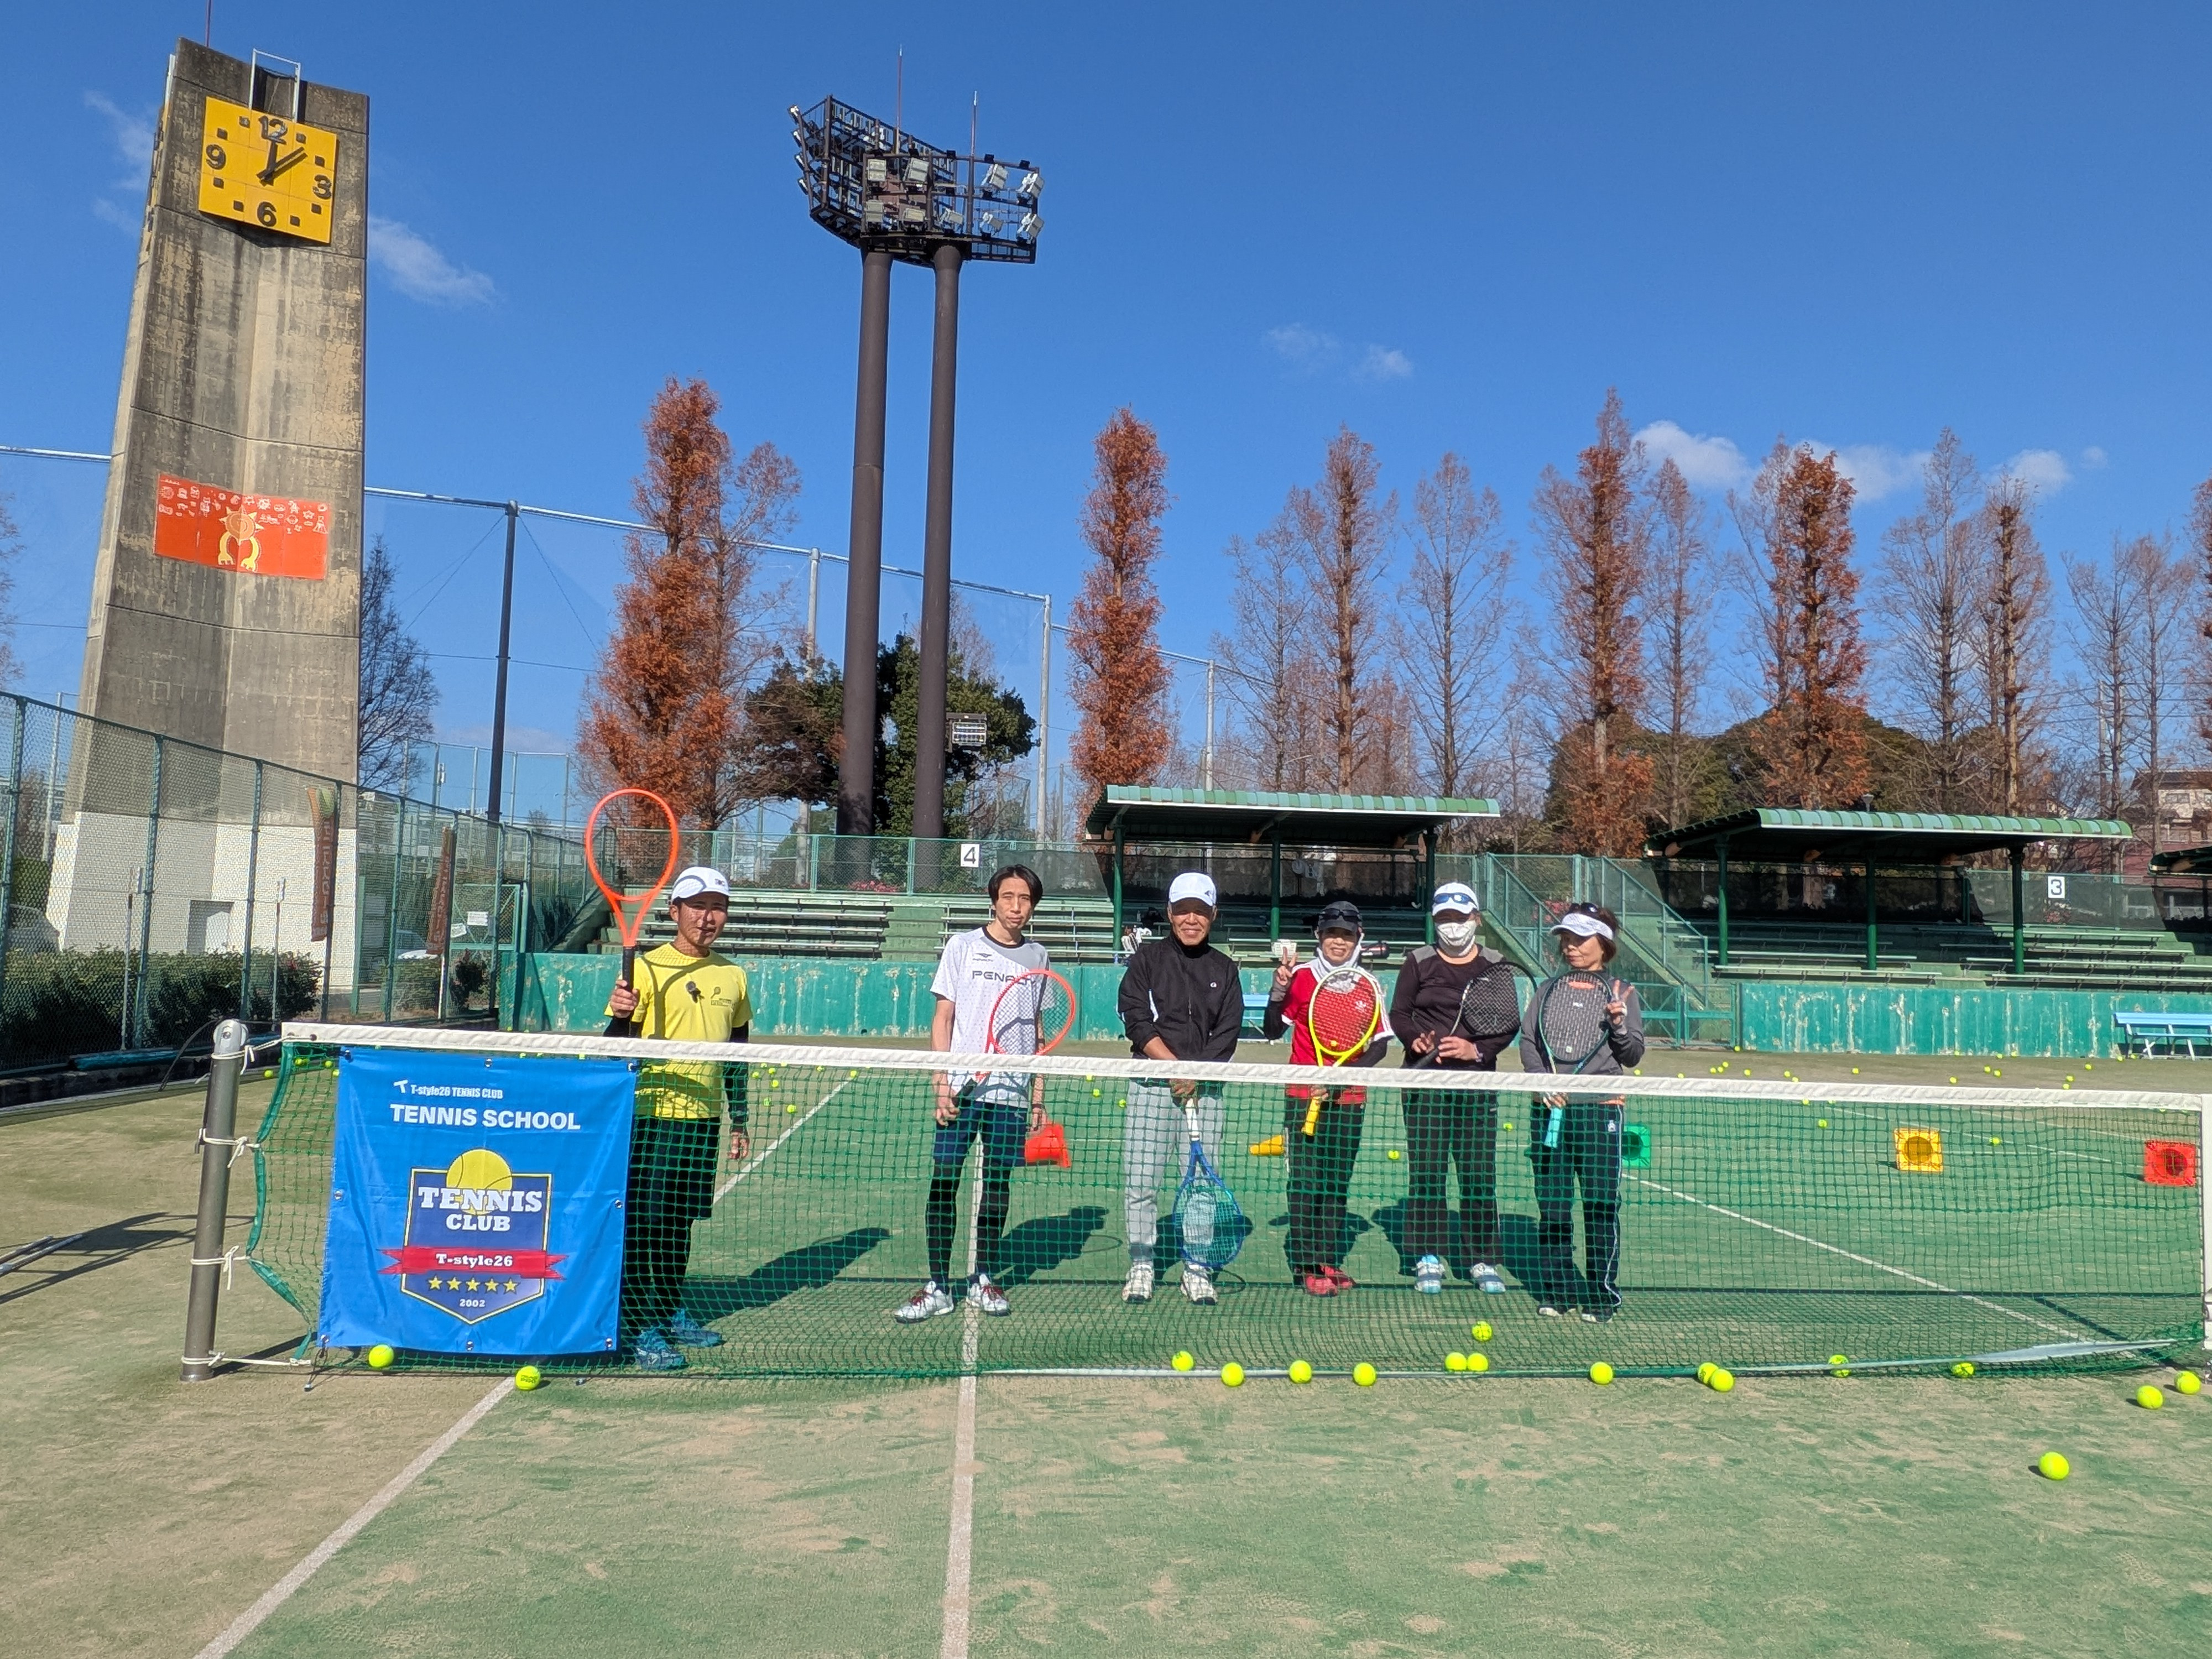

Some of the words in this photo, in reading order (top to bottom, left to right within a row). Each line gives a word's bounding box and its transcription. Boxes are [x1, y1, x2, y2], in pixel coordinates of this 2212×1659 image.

[259, 116, 288, 145] 12
[206, 144, 226, 170] 9
[312, 174, 332, 200] 3
[257, 202, 276, 227] 6
[963, 847, 976, 864] 4
[2051, 879, 2062, 895] 3
[452, 1087, 481, 1098] TENNIS
[482, 1088, 503, 1099] CLUB
[390, 1104, 477, 1126] TENNIS
[482, 1109, 581, 1130] SCHOOL
[418, 1187, 542, 1212] TENNIS
[446, 1214, 511, 1232] CLUB
[436, 1254, 513, 1268] T-style26
[460, 1299, 486, 1307] 2002
